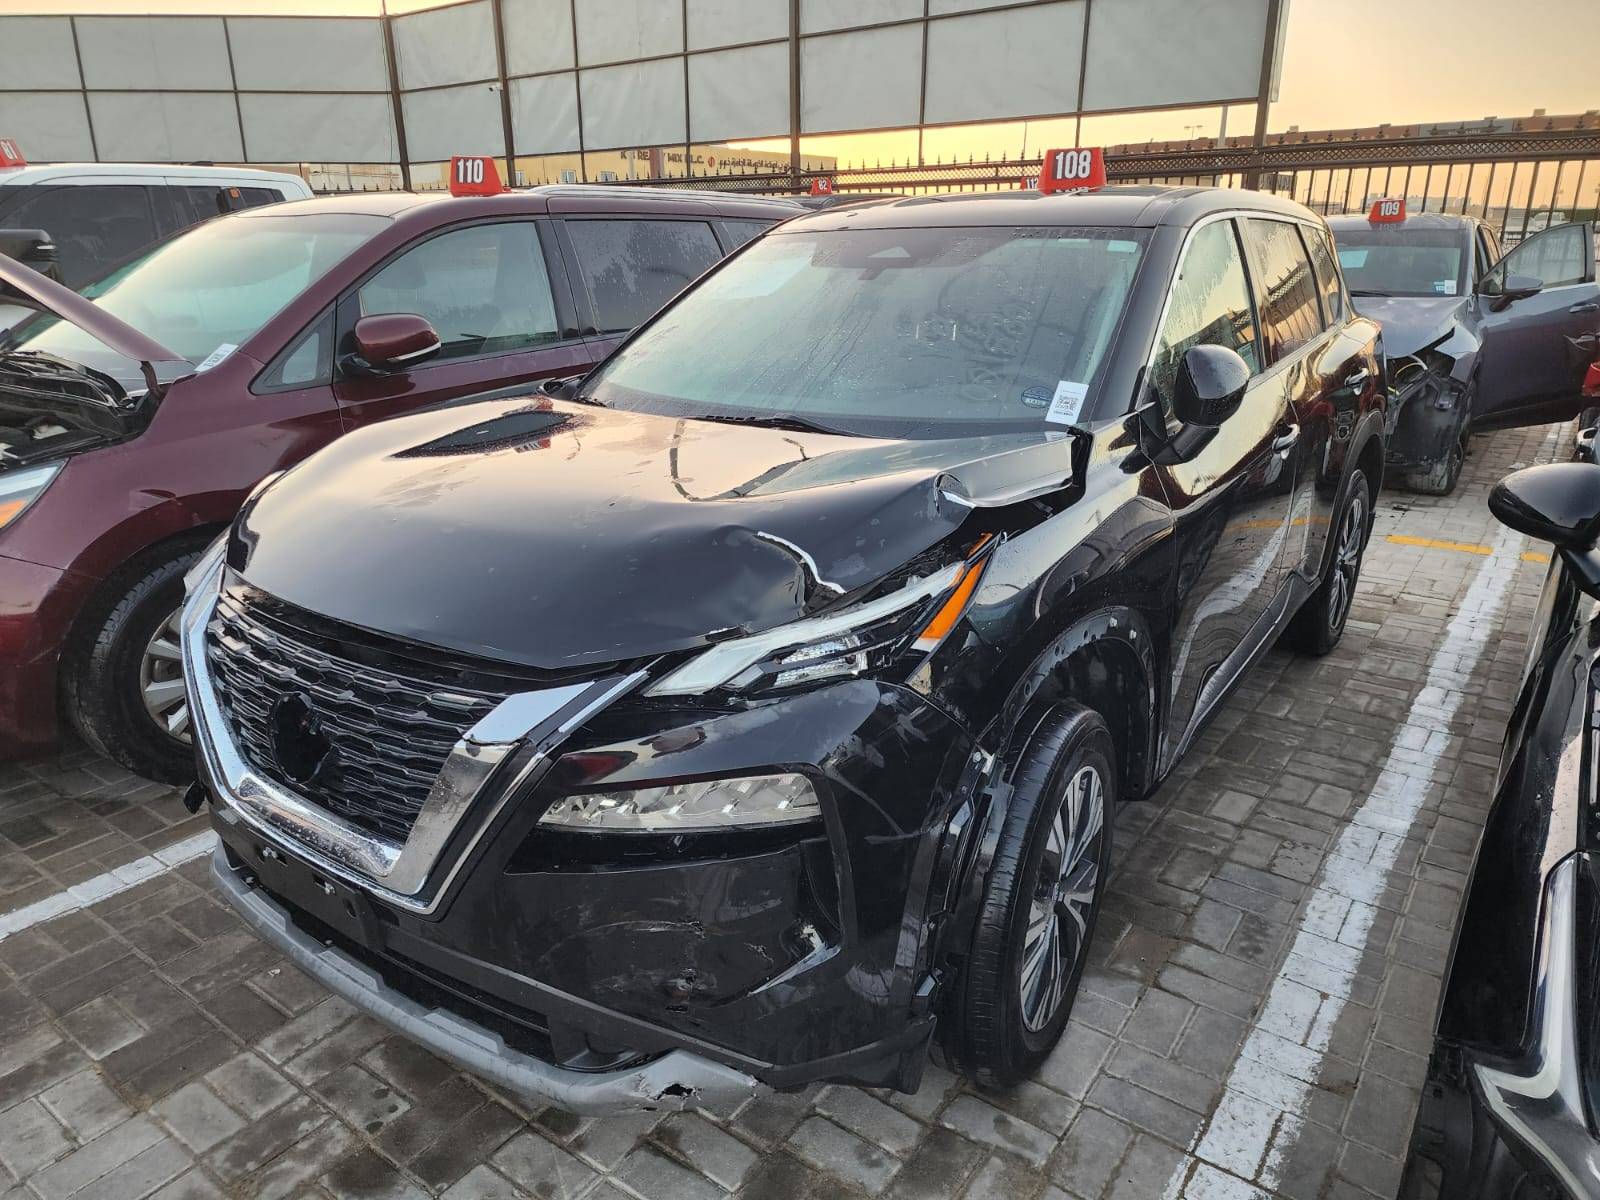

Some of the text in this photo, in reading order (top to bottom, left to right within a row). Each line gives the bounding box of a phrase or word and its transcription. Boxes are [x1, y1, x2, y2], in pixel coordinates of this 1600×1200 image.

[457, 158, 484, 184] 110
[1055, 150, 1091, 179] 108
[818, 178, 828, 190] 82
[1380, 201, 1400, 216] 109
